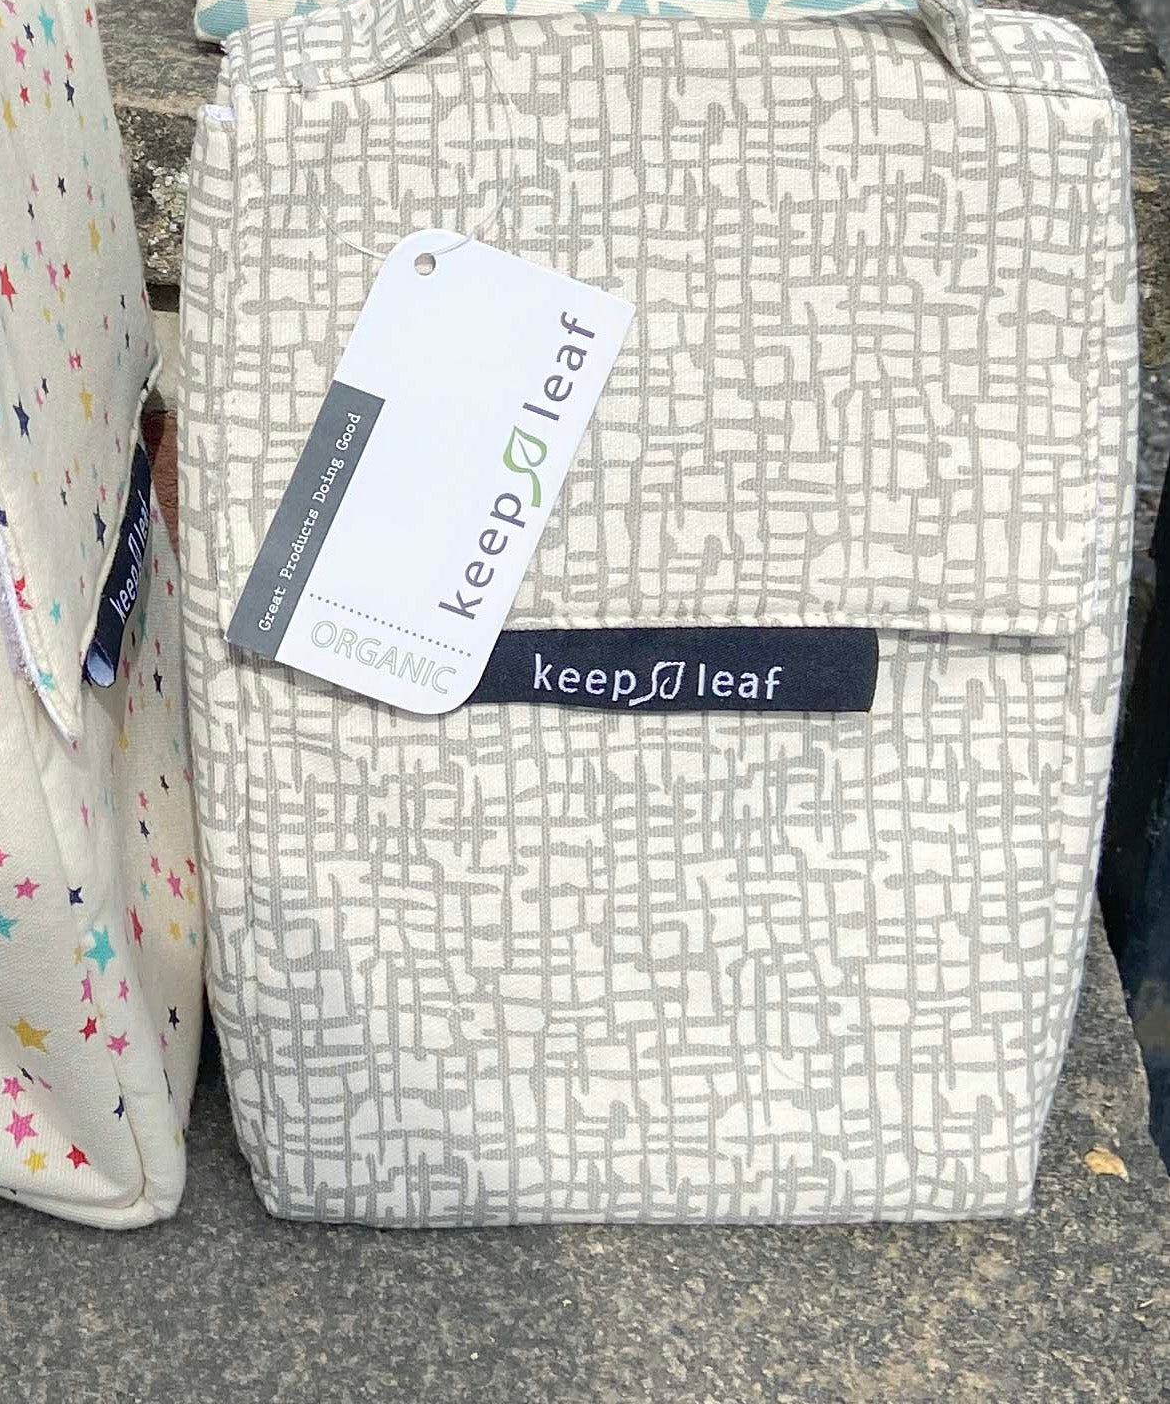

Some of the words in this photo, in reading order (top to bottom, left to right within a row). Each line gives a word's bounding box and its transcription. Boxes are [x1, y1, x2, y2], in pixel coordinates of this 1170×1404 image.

[257, 583, 287, 632] Great
[279, 508, 321, 582] Products
[311, 457, 346, 503] Doing
[335, 412, 362, 452] Good
[438, 492, 527, 621] keep
[521, 311, 596, 421] leaf
[309, 619, 458, 695] ORGANIC
[532, 652, 637, 702] keep
[696, 662, 783, 701] leaf
